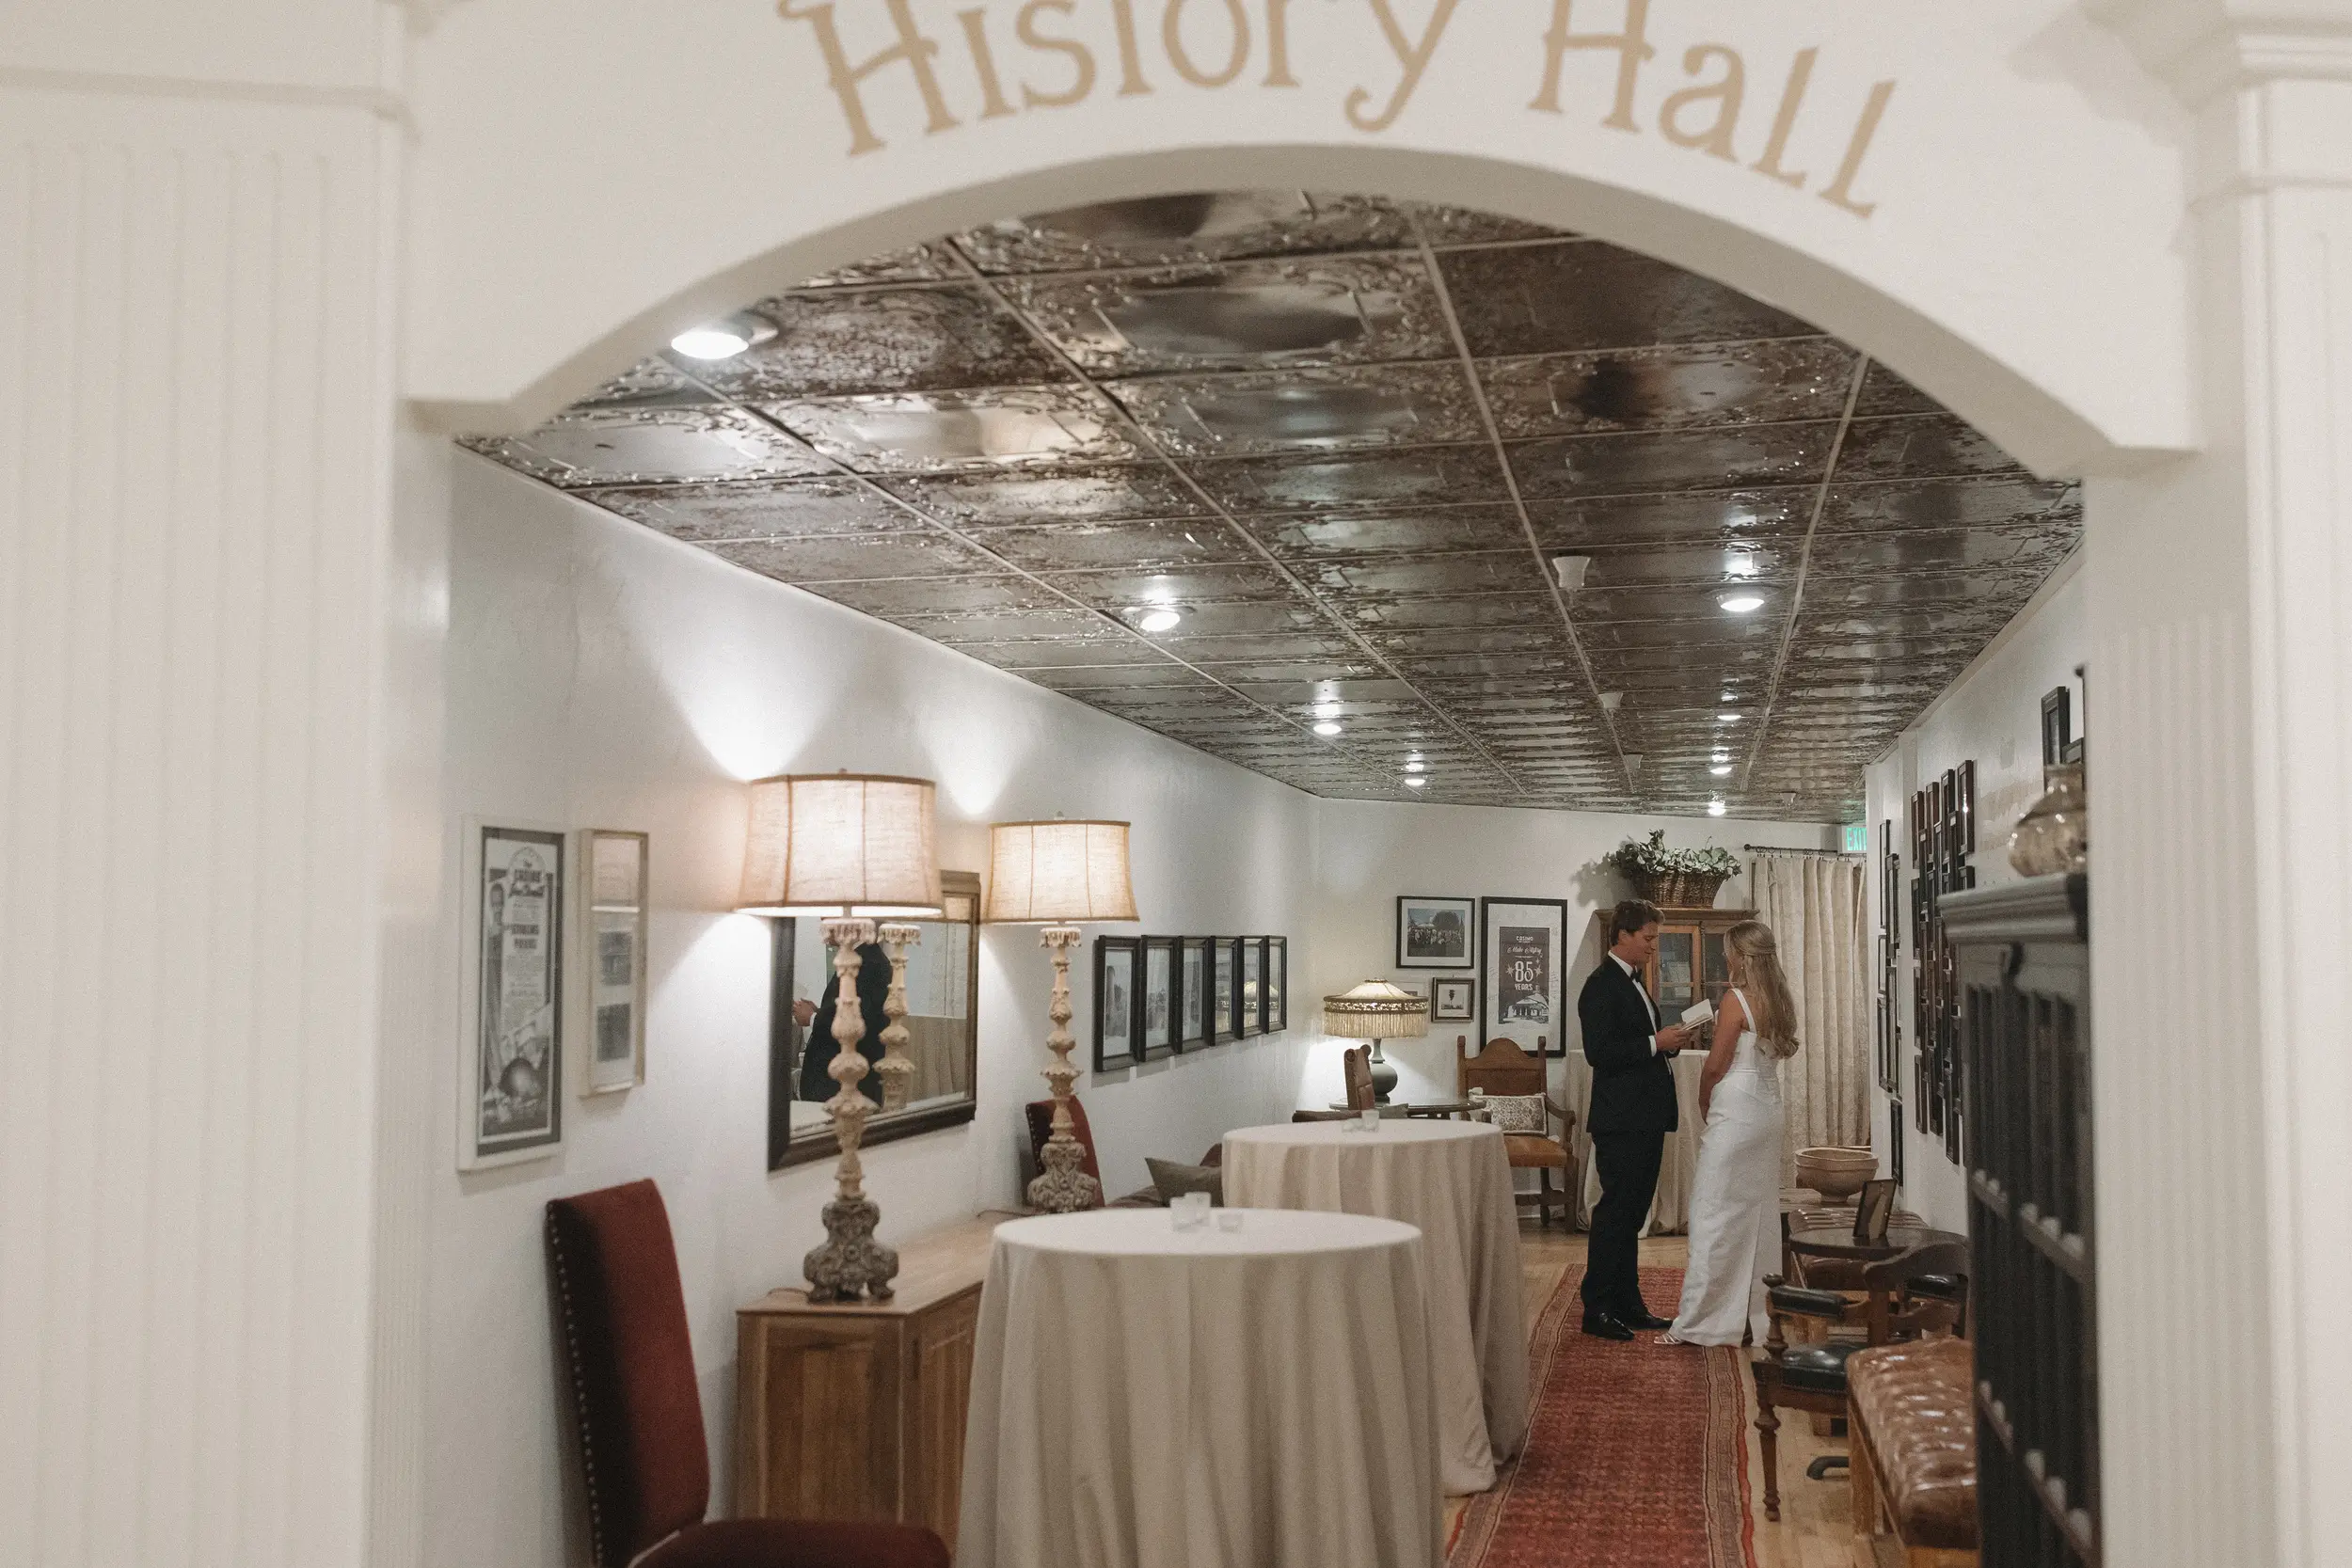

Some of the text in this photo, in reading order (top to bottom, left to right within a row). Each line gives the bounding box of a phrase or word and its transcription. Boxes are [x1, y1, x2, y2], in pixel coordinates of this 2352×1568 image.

[777, 0, 1898, 219] History Hall
[1515, 960, 1534, 983] 85
[1514, 983, 1534, 991] YEARS
